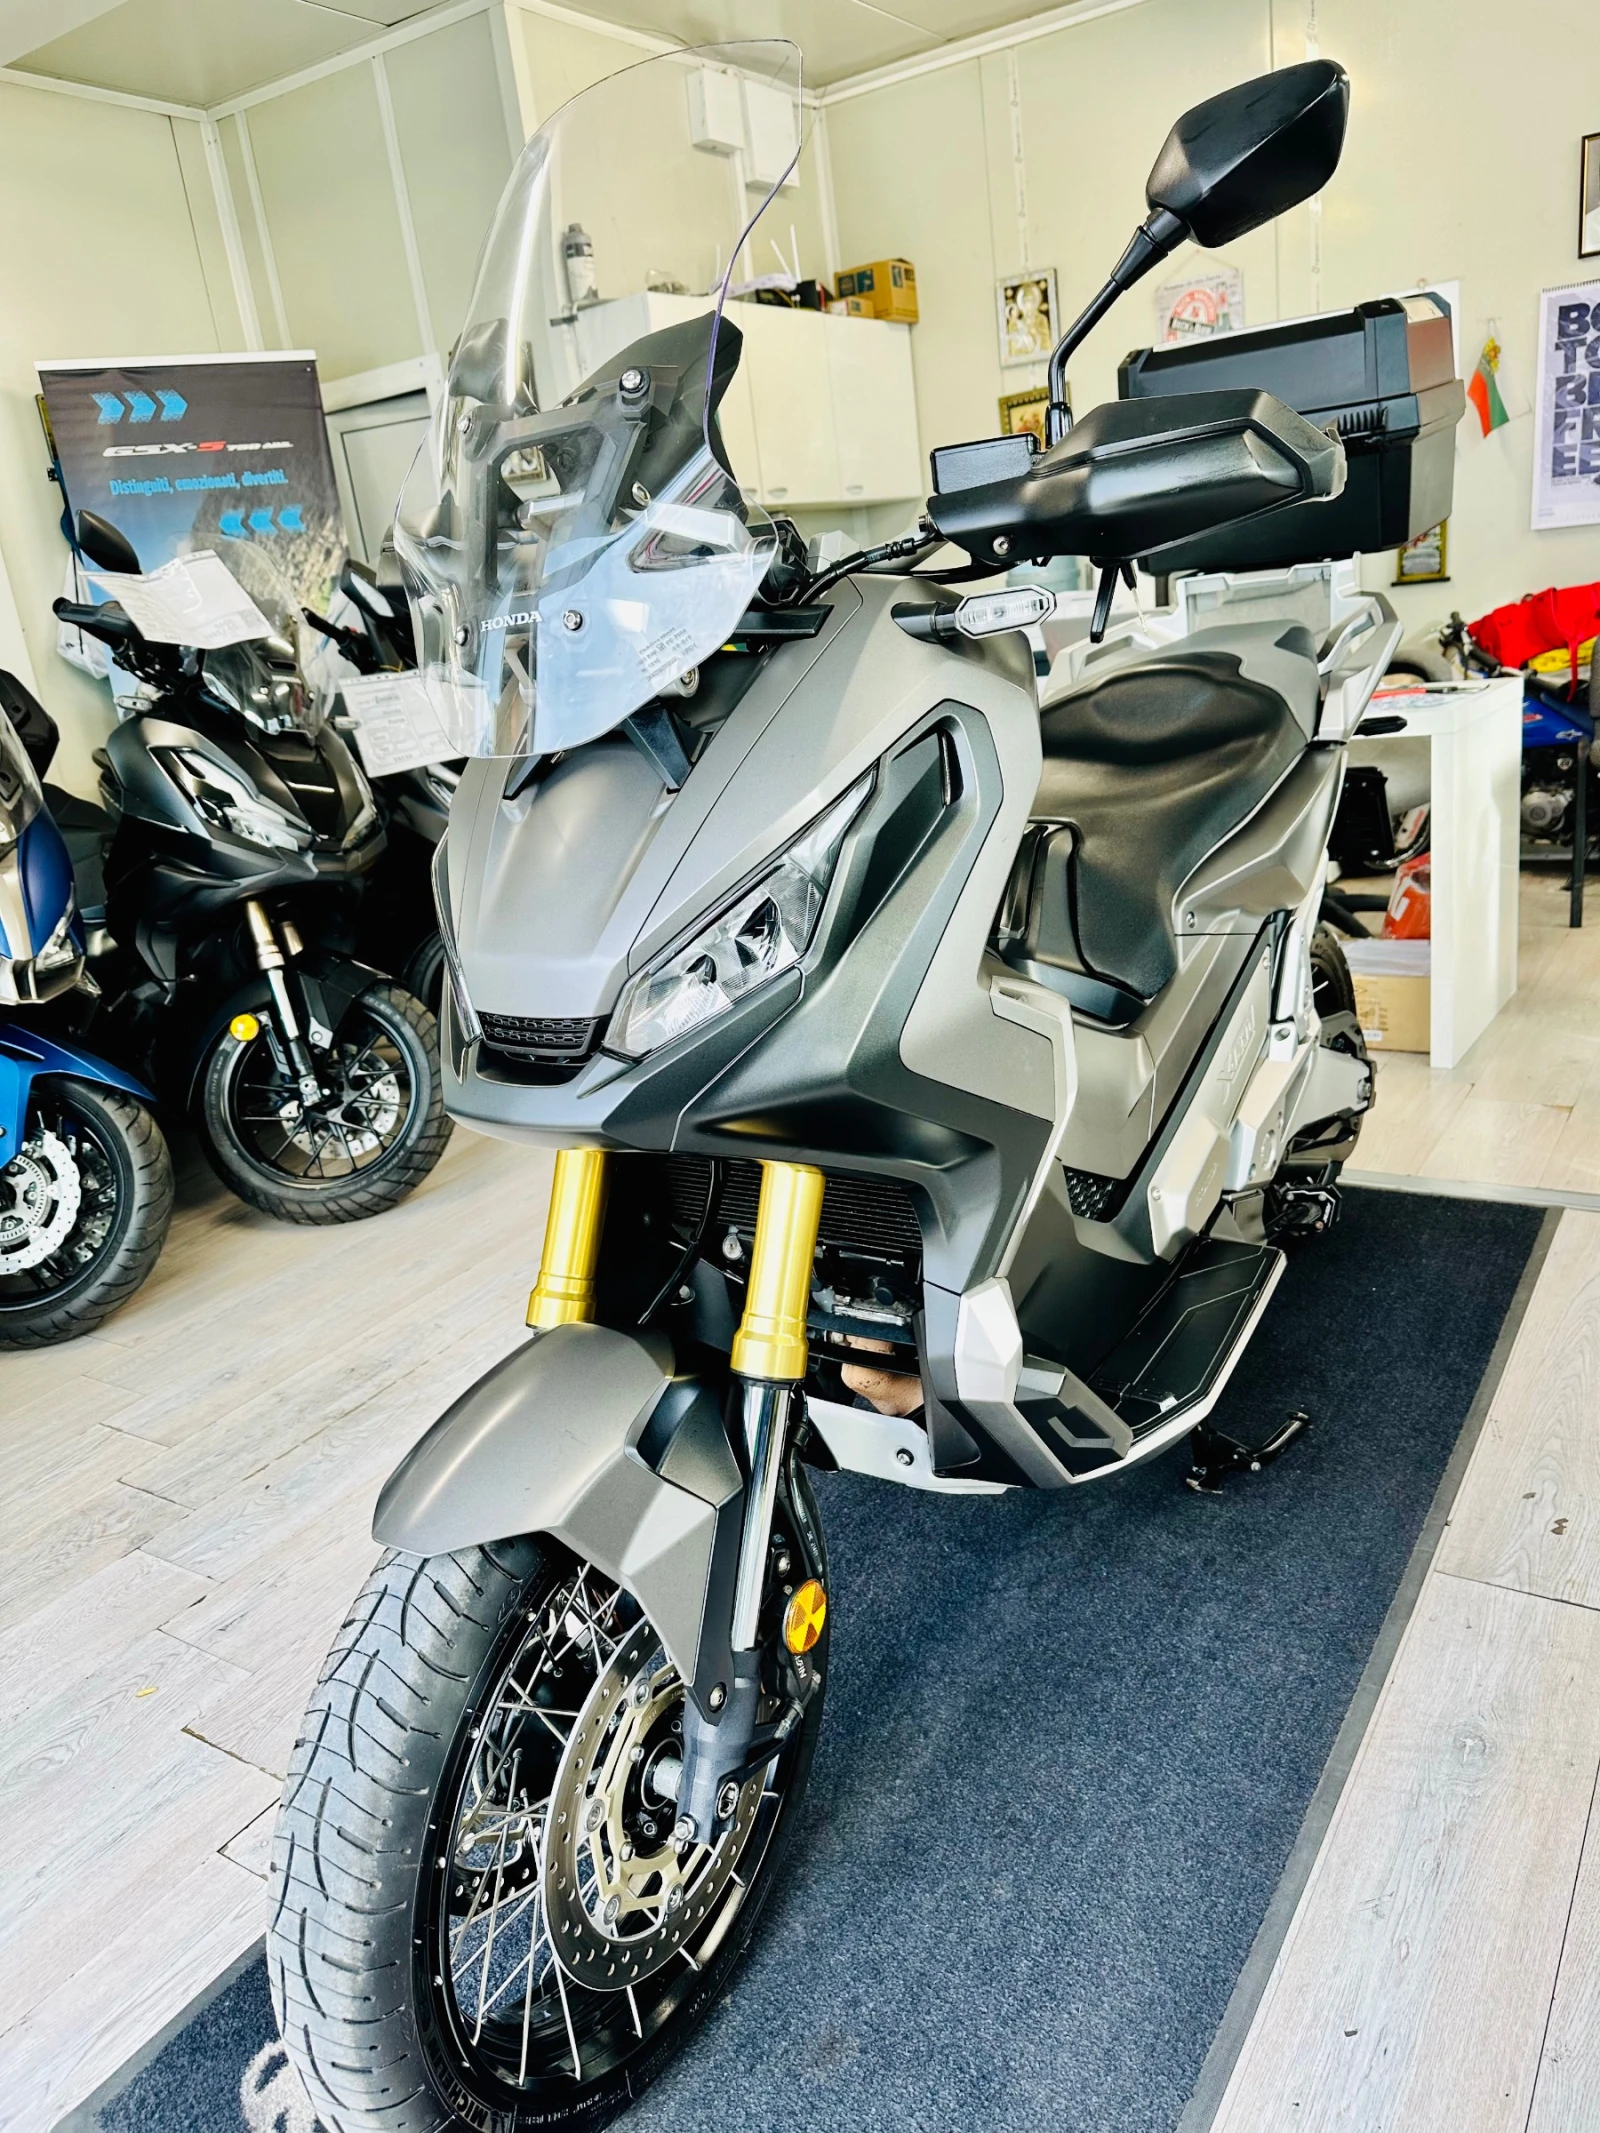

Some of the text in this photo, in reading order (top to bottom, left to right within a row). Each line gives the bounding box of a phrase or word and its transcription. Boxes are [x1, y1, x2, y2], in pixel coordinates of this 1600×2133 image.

[1558, 302, 1600, 341] B
[102, 440, 227, 458] GSX-S
[109, 468, 289, 497] Distinguiti, emozionati, divertiti.
[480, 610, 544, 633] HONDA
